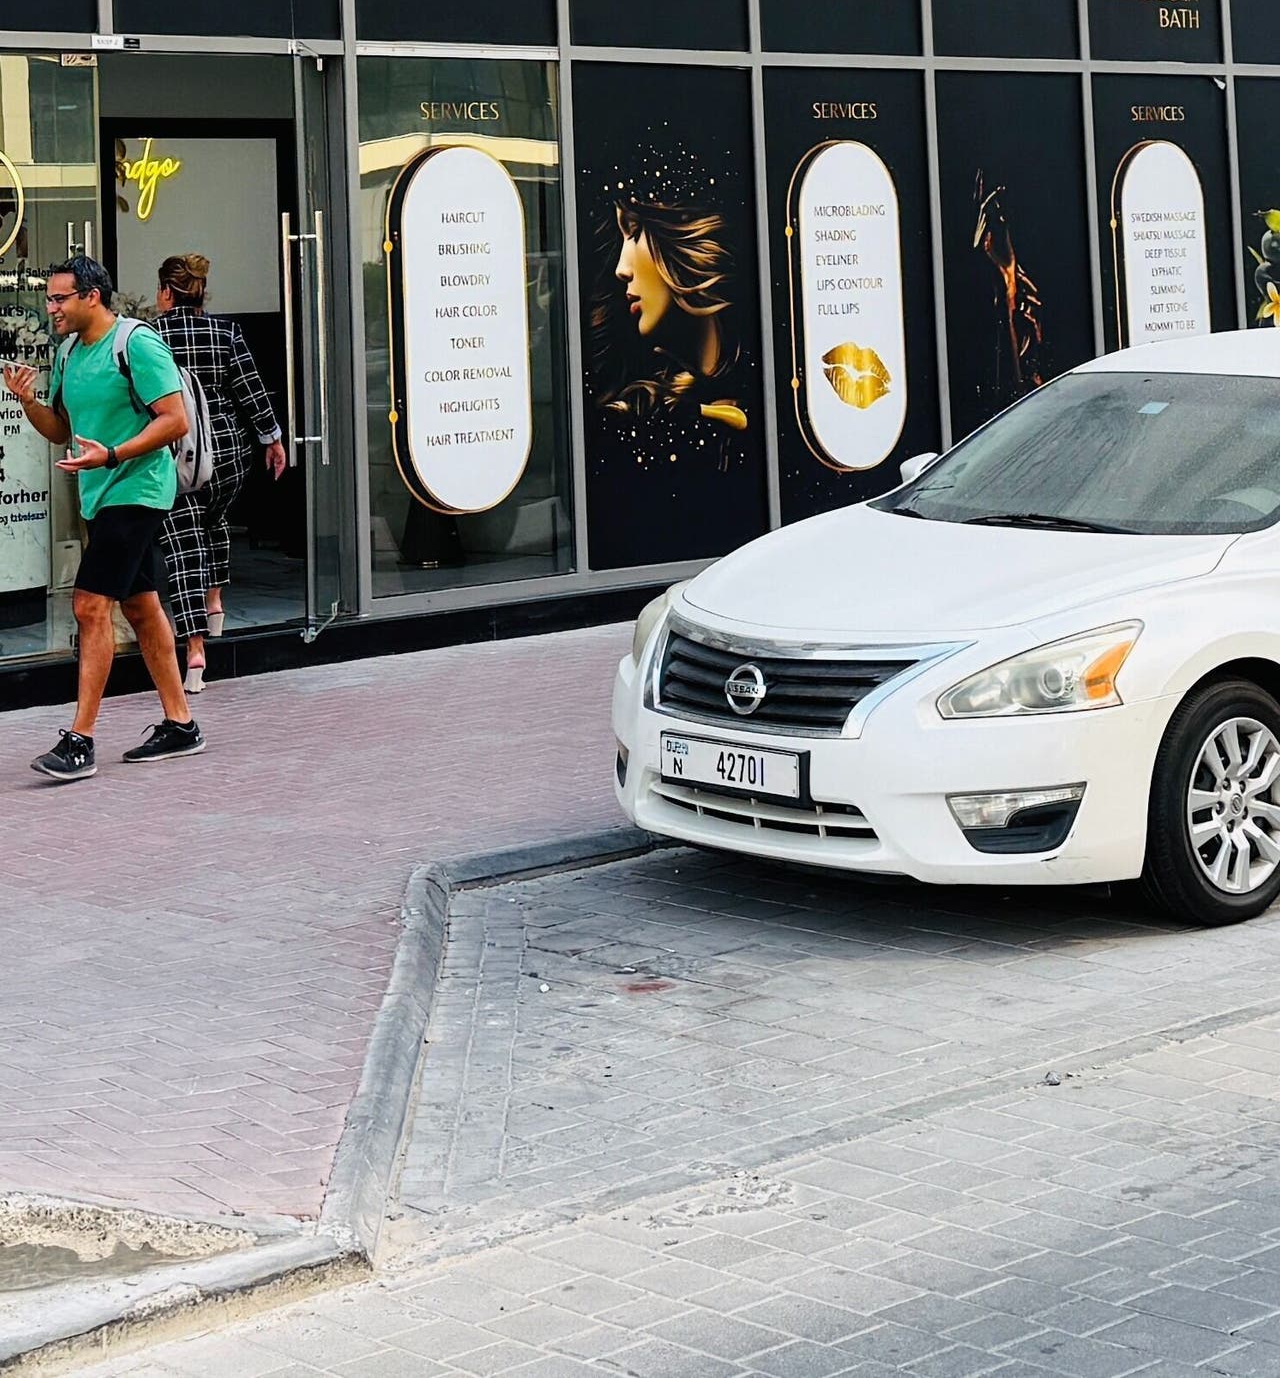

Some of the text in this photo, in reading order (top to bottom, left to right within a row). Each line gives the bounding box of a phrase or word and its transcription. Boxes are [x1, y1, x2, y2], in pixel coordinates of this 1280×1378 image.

[1159, 7, 1200, 29] BATH
[420, 101, 499, 121] SERVICES
[813, 102, 877, 120] SERVICES
[1131, 106, 1185, 122] SERVICES
[441, 211, 485, 224] HAIRCUT
[814, 204, 886, 217] MICROBLADING
[1131, 211, 1196, 223] SWEDISH MASSAGE
[815, 229, 857, 242] SHADING
[1163, 229, 1196, 240] MASSAGE
[438, 242, 491, 256] BRUSHING
[1145, 248, 1162, 259] DEEP
[816, 254, 859, 267] EYELINER
[440, 273, 491, 288] BLOWDRY
[817, 276, 883, 291] LIPS CONTOUR
[435, 304, 498, 318] HAIR COLOR
[818, 302, 860, 316] FULL LIPS
[450, 336, 485, 350] TONER
[24, 344, 50, 360] PM
[424, 365, 512, 384] COLOR REMOVAL
[439, 397, 500, 413] HIGHLIGHTS
[426, 427, 514, 447] HAIR TREATMENT
[673, 757, 683, 775] N
[716, 751, 764, 787] 42701
